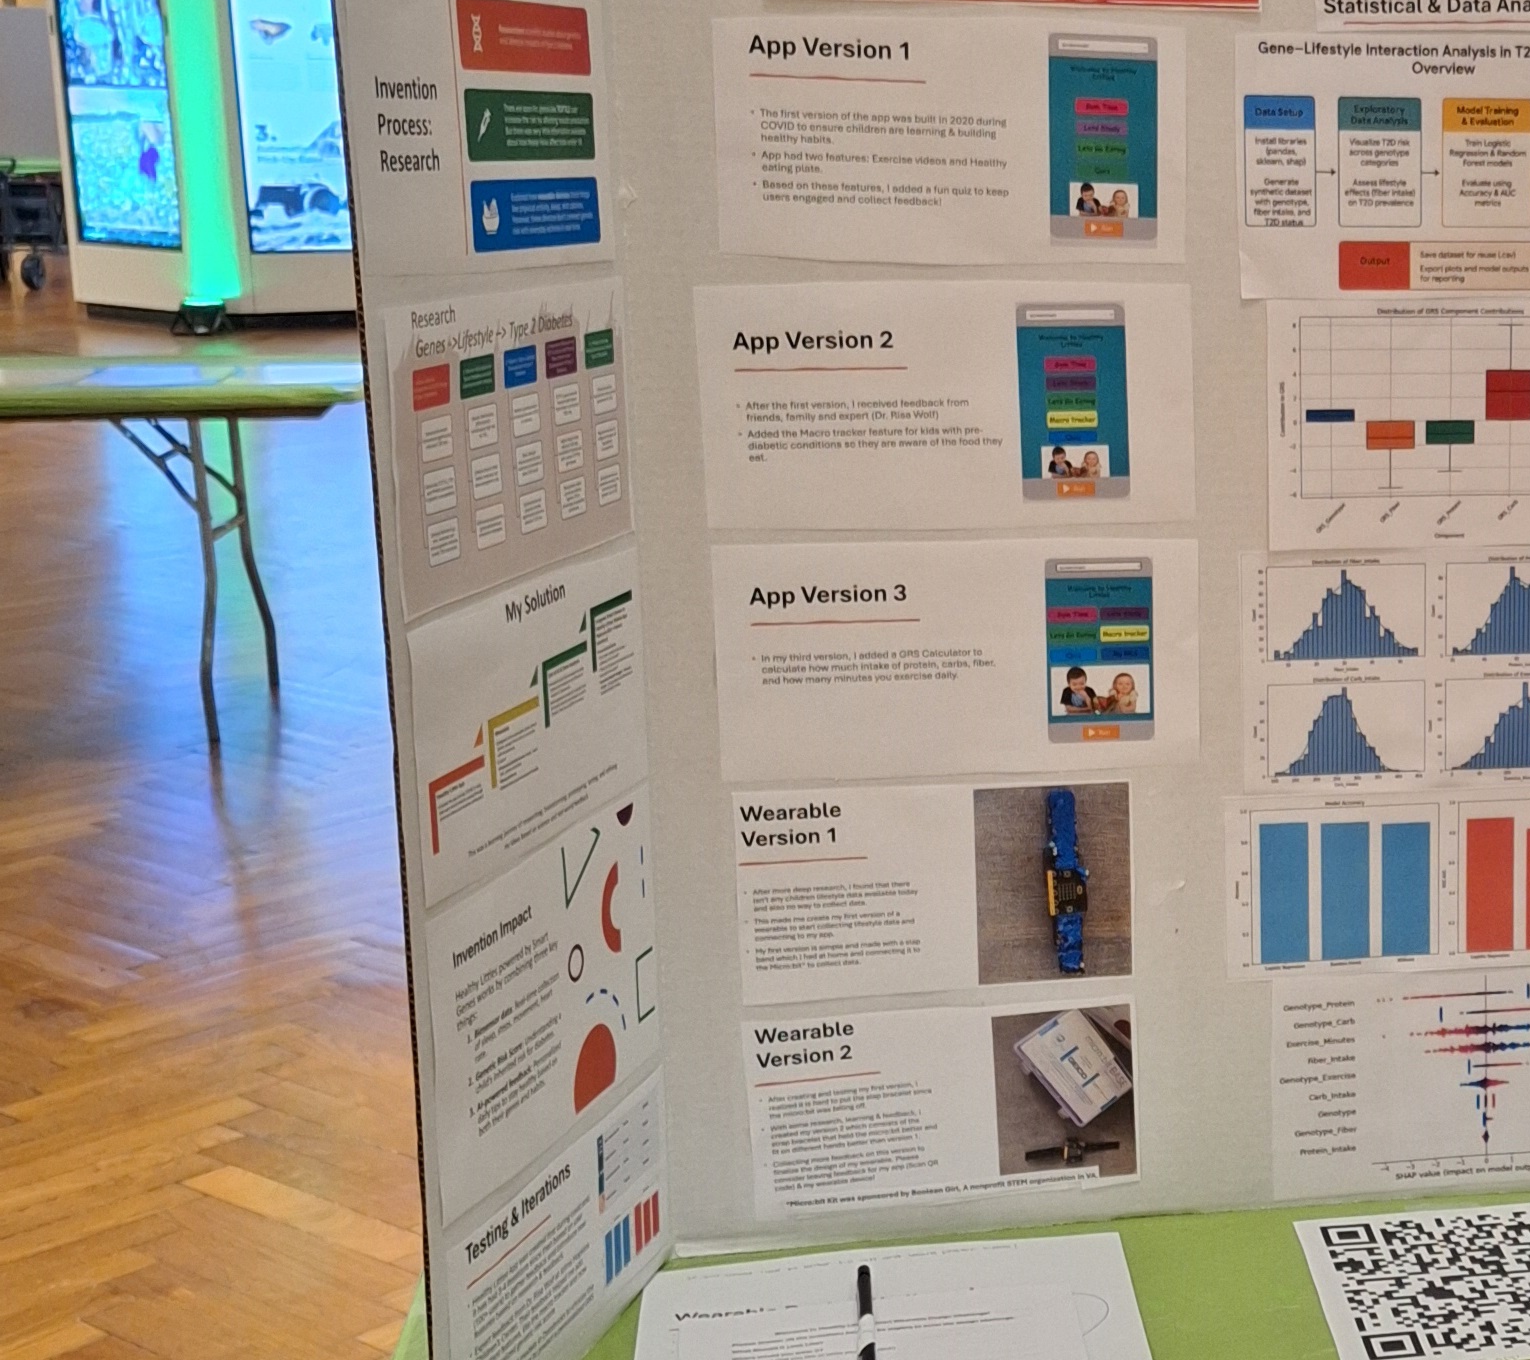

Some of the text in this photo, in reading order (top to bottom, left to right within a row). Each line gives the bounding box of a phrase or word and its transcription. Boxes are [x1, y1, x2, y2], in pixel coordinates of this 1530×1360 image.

[749, 35, 911, 60] App Version 1
[1365, 43, 1439, 58] Interaction
[1442, 44, 1497, 61] Analysis
[1500, 45, 1512, 58] in
[1411, 62, 1476, 76] Overview
[375, 75, 437, 101] Invention
[760, 108, 1007, 128] The first version of the app was built in 2020 during
[1255, 107, 1303, 118] Data Setup
[1354, 104, 1405, 117] Exploratory
[1456, 105, 1519, 118] Model Training
[378, 113, 432, 136] Process:
[1350, 116, 1409, 126] Data Analysis
[1470, 116, 1514, 127] Evaluation
[380, 148, 440, 172] Research
[1359, 255, 1391, 268] Output
[411, 305, 456, 329] Research
[416, 336, 446, 358] Genes
[509, 320, 529, 338] Type
[530, 318, 536, 335] 2
[538, 314, 573, 333] Diabetes
[732, 330, 895, 355] App Version 2
[745, 400, 770, 411] After
[772, 400, 788, 410] the
[789, 400, 809, 410] first
[857, 399, 898, 409] received
[900, 398, 944, 408] feedback
[946, 398, 969, 408] from
[505, 585, 566, 624] My Solution
[750, 583, 908, 609] App Version 3
[761, 654, 770, 663] In
[772, 655, 787, 664] my
[788, 653, 811, 662] third
[858, 650, 889, 660] added
[921, 648, 971, 658] Calculator
[973, 648, 983, 657] to
[740, 802, 842, 823] Wearable
[741, 827, 838, 848] Version 1
[452, 905, 532, 969] Invention Impact
[1283, 1000, 1355, 1013] Genotype_Protein
[1293, 1017, 1356, 1030] Genotype_Carb
[754, 1021, 854, 1045] Wearable
[756, 1045, 854, 1070] Version 2
[1307, 1055, 1356, 1065] Fiber_Intake
[1279, 1071, 1356, 1085] Genotype_Exercise
[1308, 1090, 1356, 1101] Carb_Intake
[1318, 1108, 1357, 1119] Genotype
[1294, 1126, 1357, 1139] Genotype_Fiber
[1300, 1144, 1356, 1156] Protein_Intake
[1395, 1171, 1417, 1181] SHAP
[1419, 1169, 1441, 1179] value
[1443, 1166, 1473, 1179] (impact
[1487, 1163, 1513, 1173] model
[465, 1162, 571, 1265] Testing & Iterations
